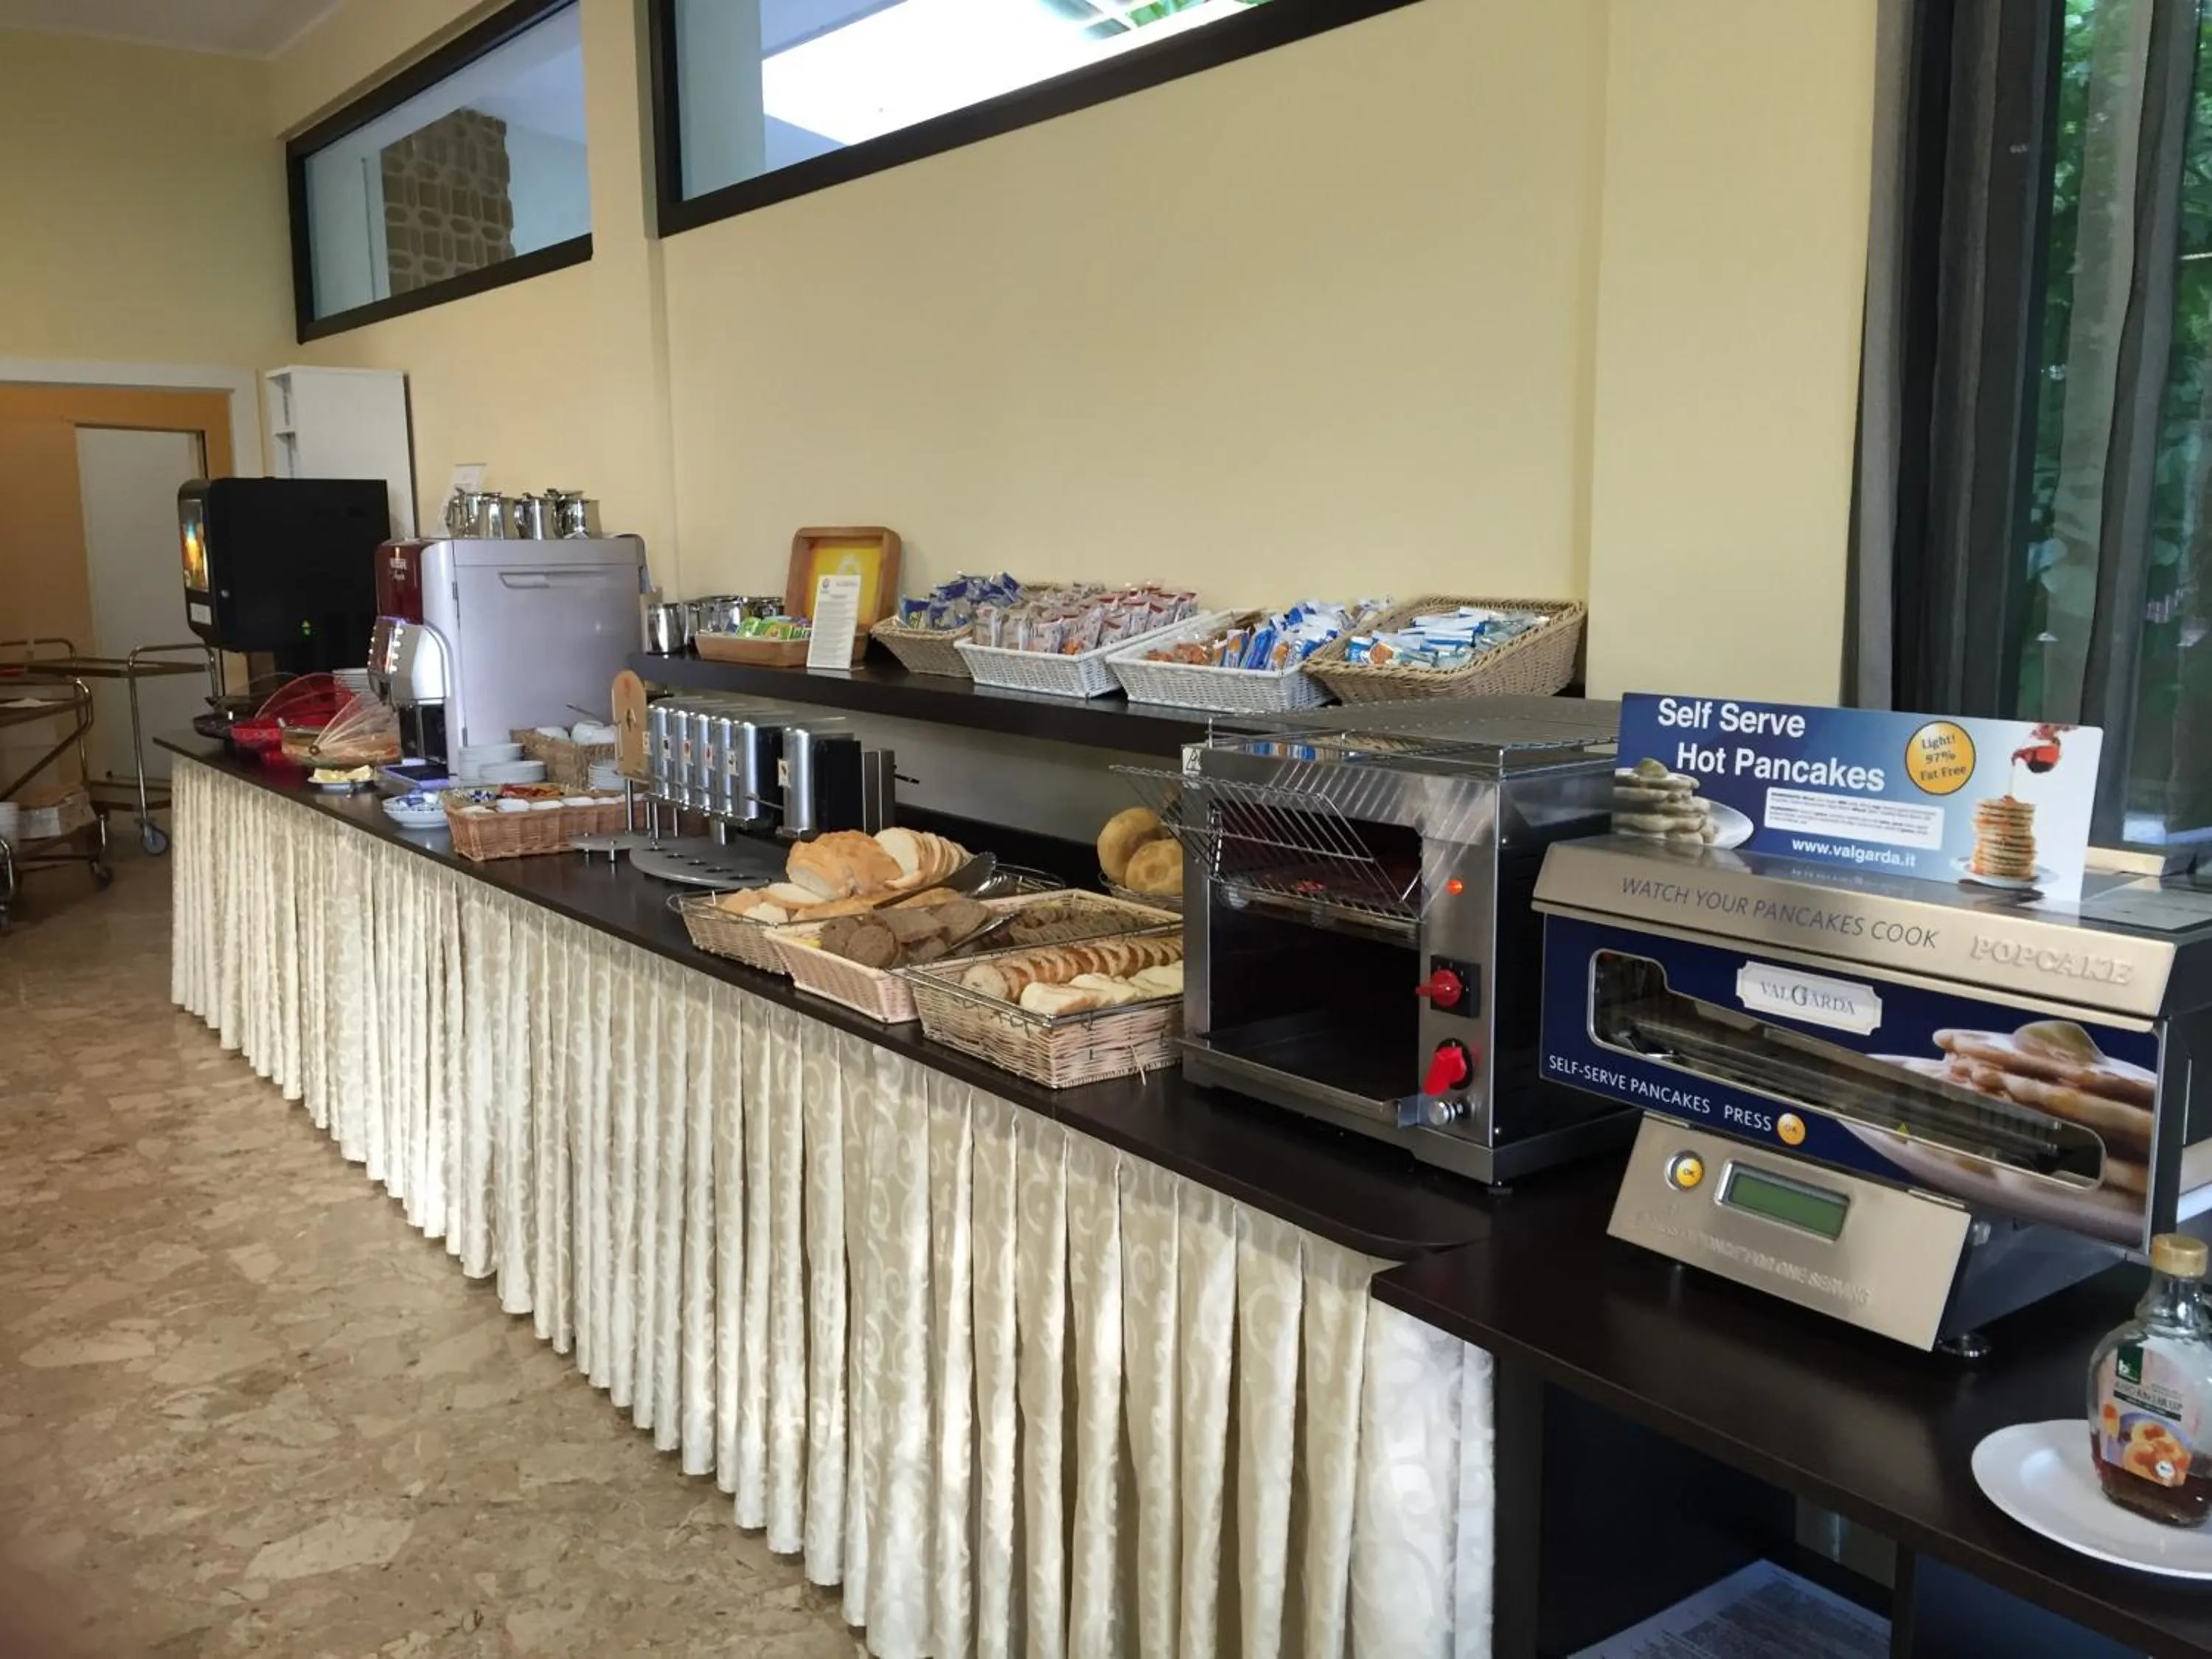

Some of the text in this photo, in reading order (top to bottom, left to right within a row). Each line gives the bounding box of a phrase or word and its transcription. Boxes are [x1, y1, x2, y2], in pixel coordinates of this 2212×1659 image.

[1658, 698, 1806, 738] Self Serve
[1921, 734, 1956, 750] Light!
[1925, 751, 1956, 765] 97%
[1676, 742, 1885, 792] Hot Pancakes
[1920, 766, 1966, 781] Fat Free
[1792, 838, 1916, 868] www.valgarda.it
[1622, 877, 1940, 950] WATCH YOUR PANCAKES COOK
[1970, 935, 2133, 986] POPCAKE
[1549, 1055, 1627, 1091] SELF-SERVE
[1630, 1078, 1711, 1114] PANCAKES
[1724, 1105, 1773, 1133] PRESS
